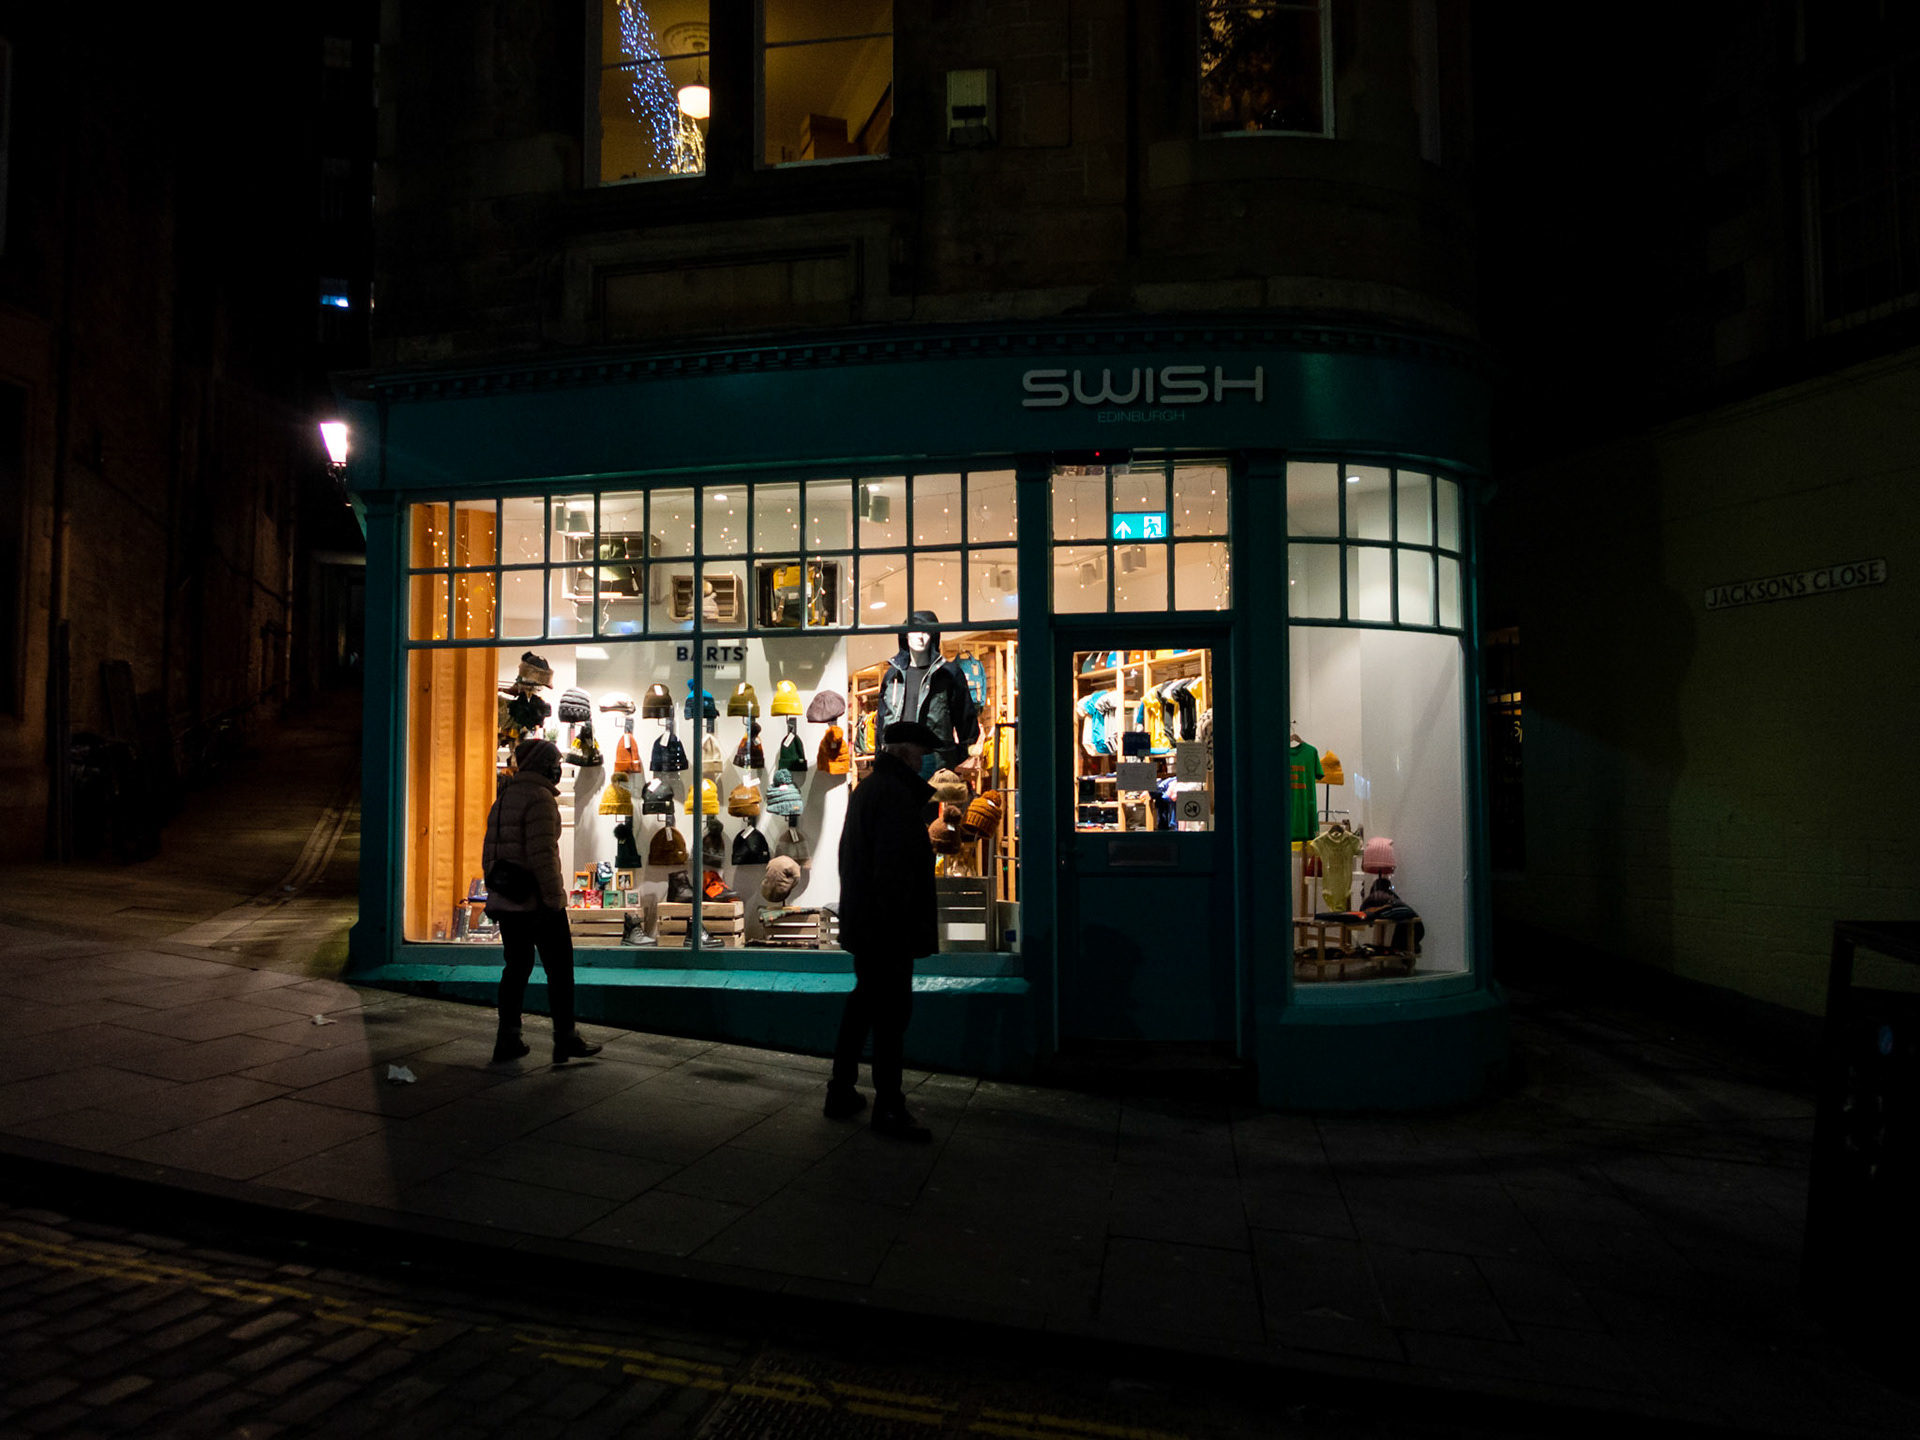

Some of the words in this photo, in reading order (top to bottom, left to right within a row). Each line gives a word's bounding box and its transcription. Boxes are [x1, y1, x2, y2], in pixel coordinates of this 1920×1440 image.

[1021, 365, 1264, 407] SWISH
[1098, 410, 1185, 423] EDINBURGH
[1709, 575, 1806, 607] JACKSON'S
[1813, 562, 1880, 589] CLOSE
